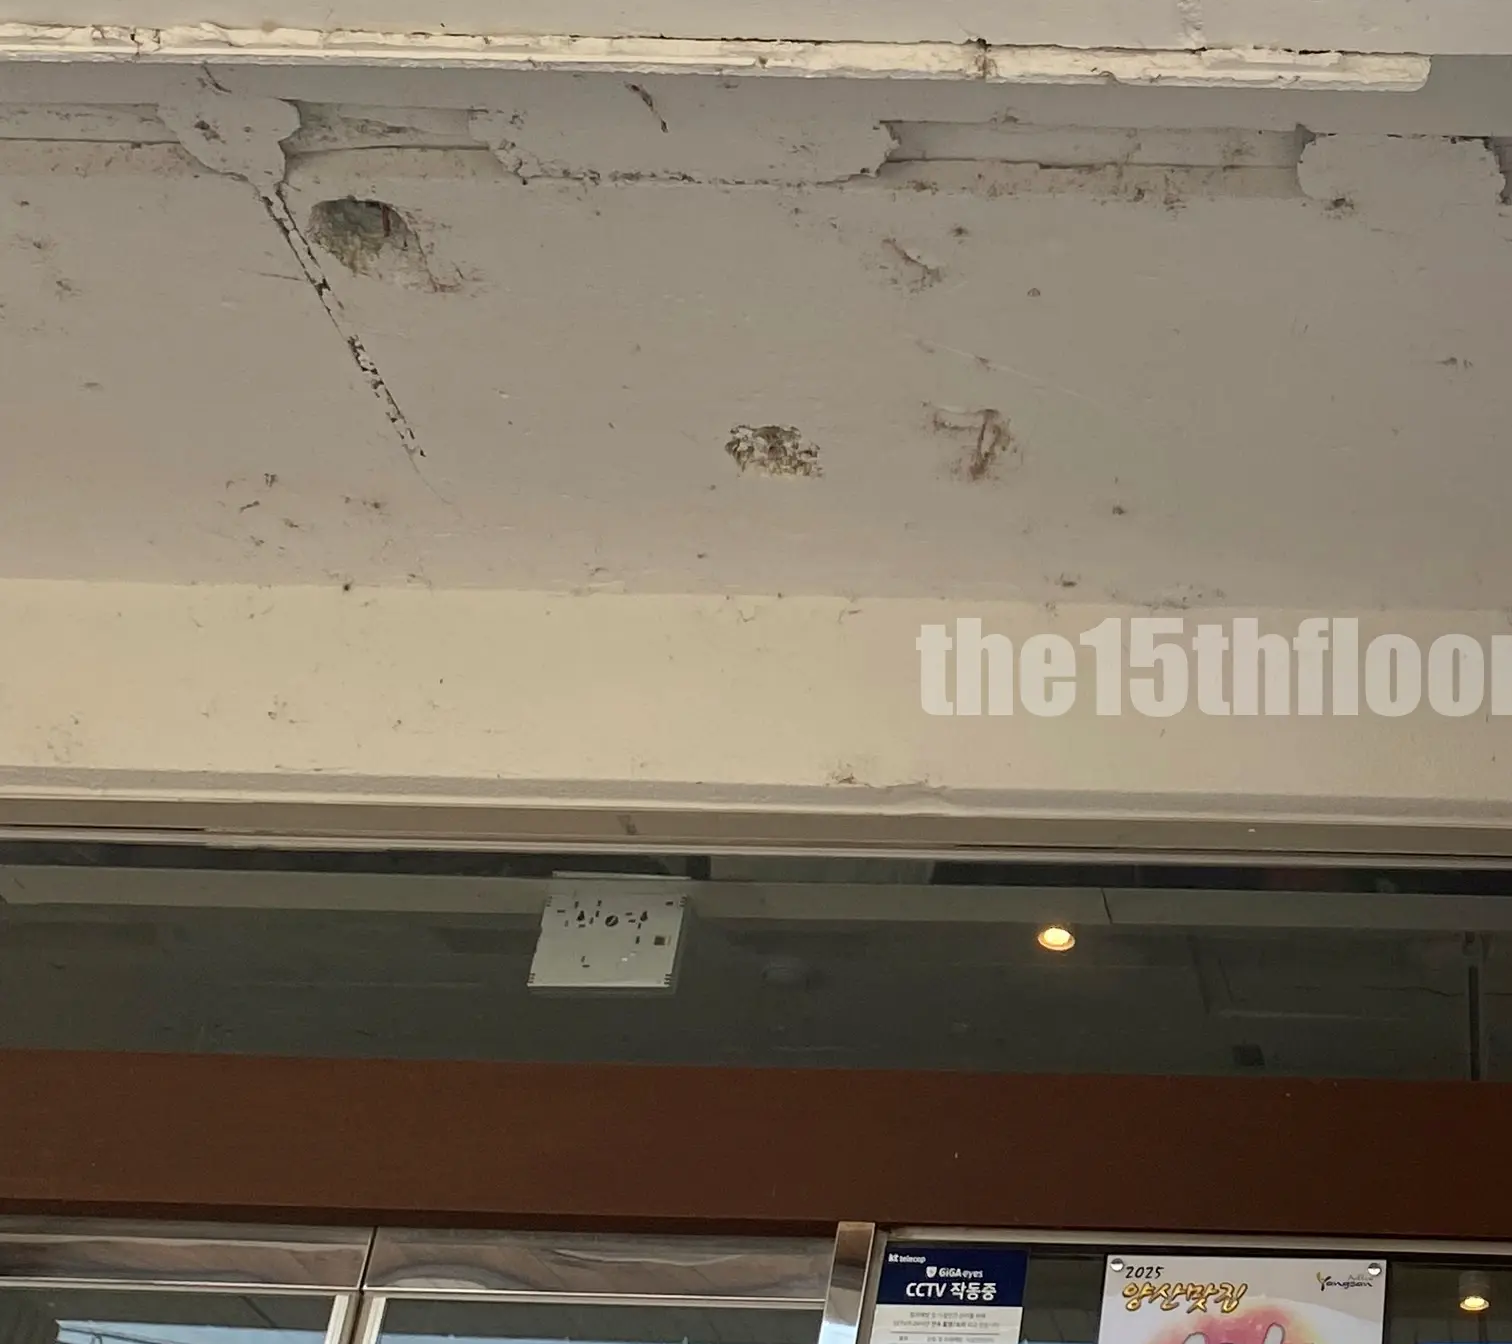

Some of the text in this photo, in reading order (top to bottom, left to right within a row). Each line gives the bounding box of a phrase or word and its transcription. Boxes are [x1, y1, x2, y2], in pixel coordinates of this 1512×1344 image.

[1125, 1265, 1164, 1279] 2025
[1316, 1271, 1373, 1291] Yangsan
[906, 1282, 997, 1301] CCTV 작동중
[1122, 1282, 1247, 1313] 양산맛집
